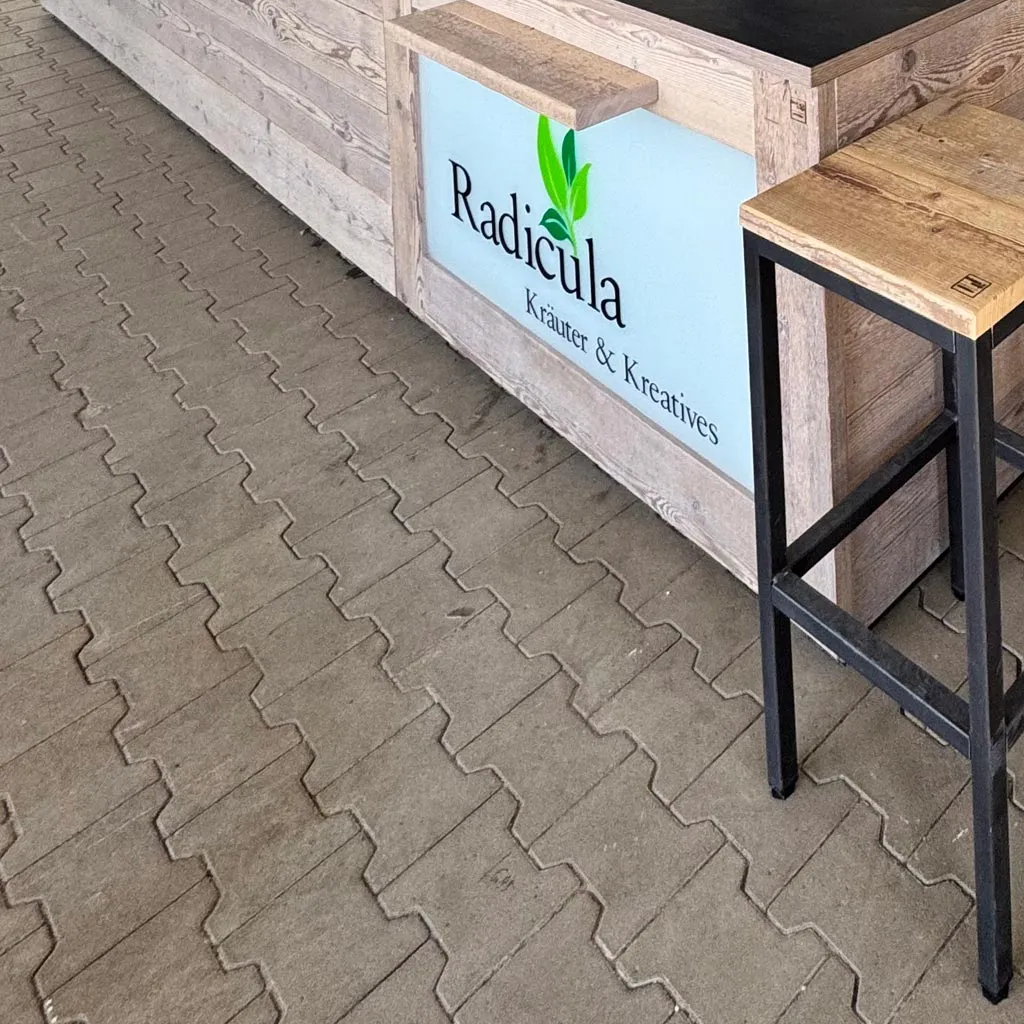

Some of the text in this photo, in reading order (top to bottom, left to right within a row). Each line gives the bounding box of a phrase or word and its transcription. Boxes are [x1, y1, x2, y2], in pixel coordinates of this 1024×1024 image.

[449, 159, 626, 327] Radicula
[525, 288, 719, 446] Kräuter & Kreatives
